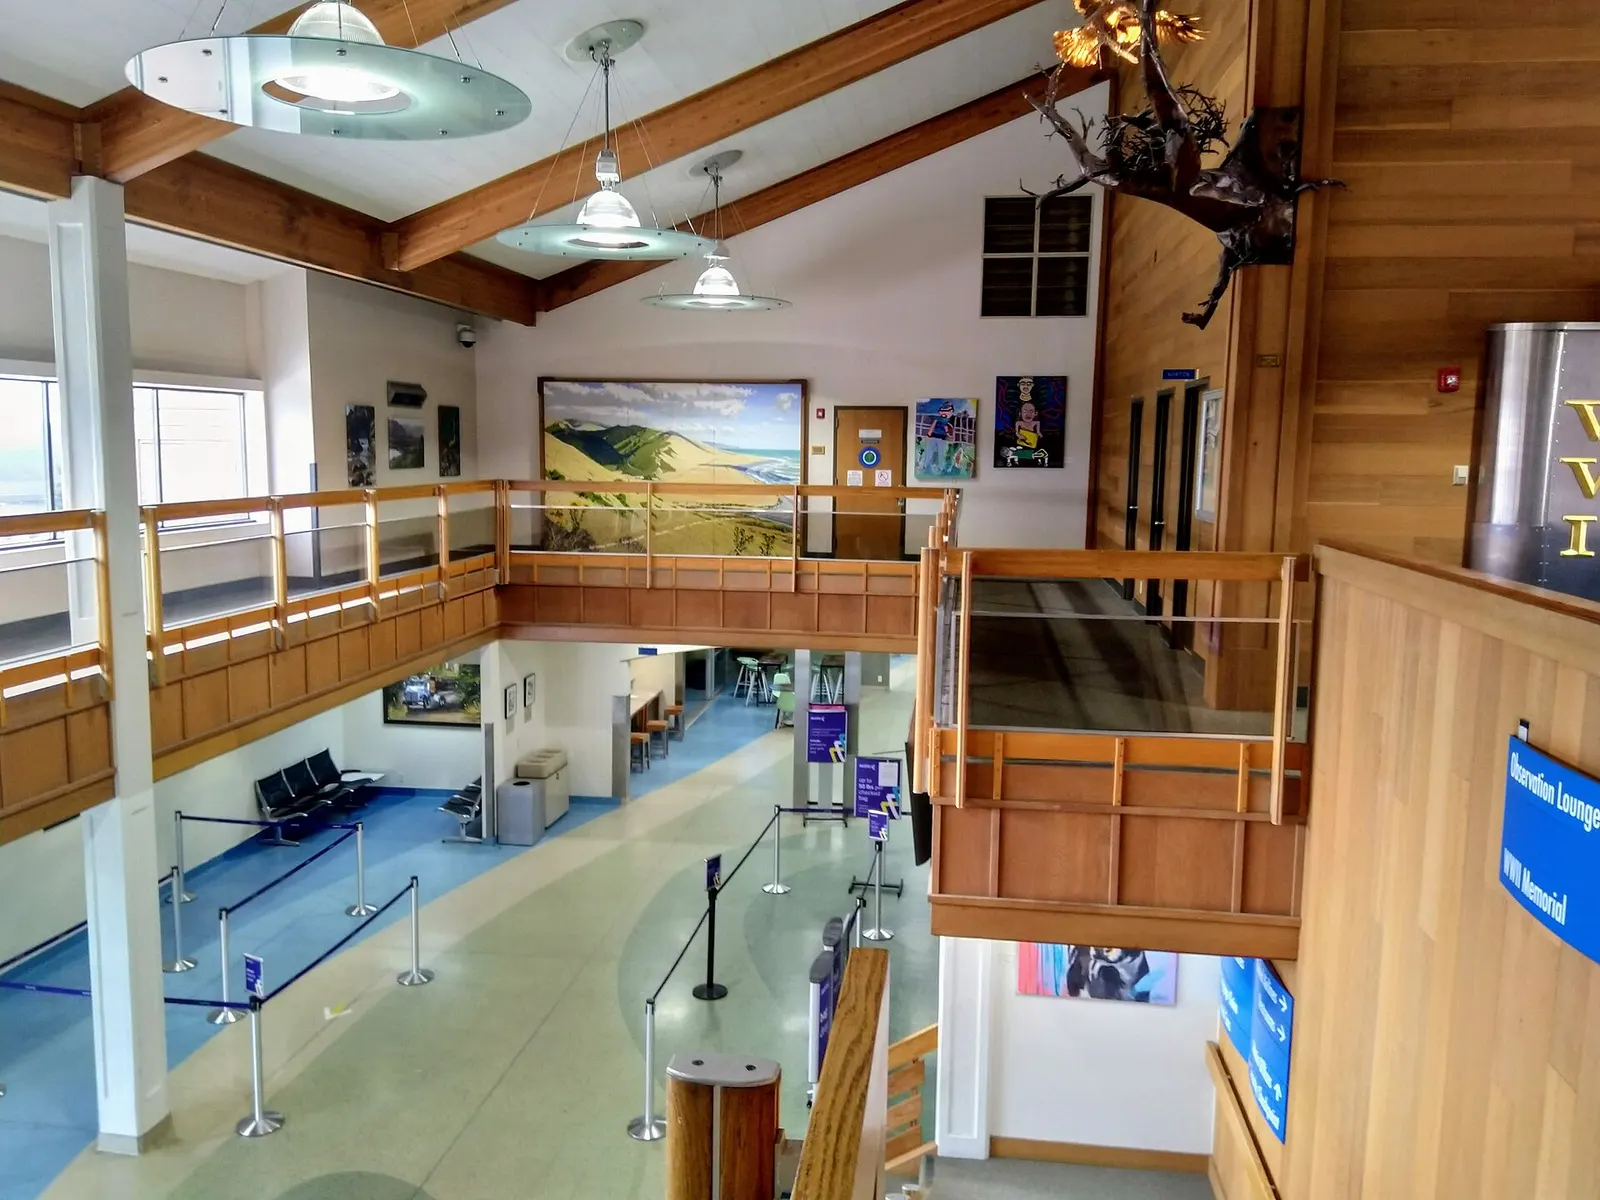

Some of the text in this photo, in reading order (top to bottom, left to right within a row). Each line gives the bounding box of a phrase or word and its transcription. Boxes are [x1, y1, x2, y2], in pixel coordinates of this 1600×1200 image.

[1510, 751, 1600, 833] Observation Lounge
[1521, 867, 1568, 926] Memorial
